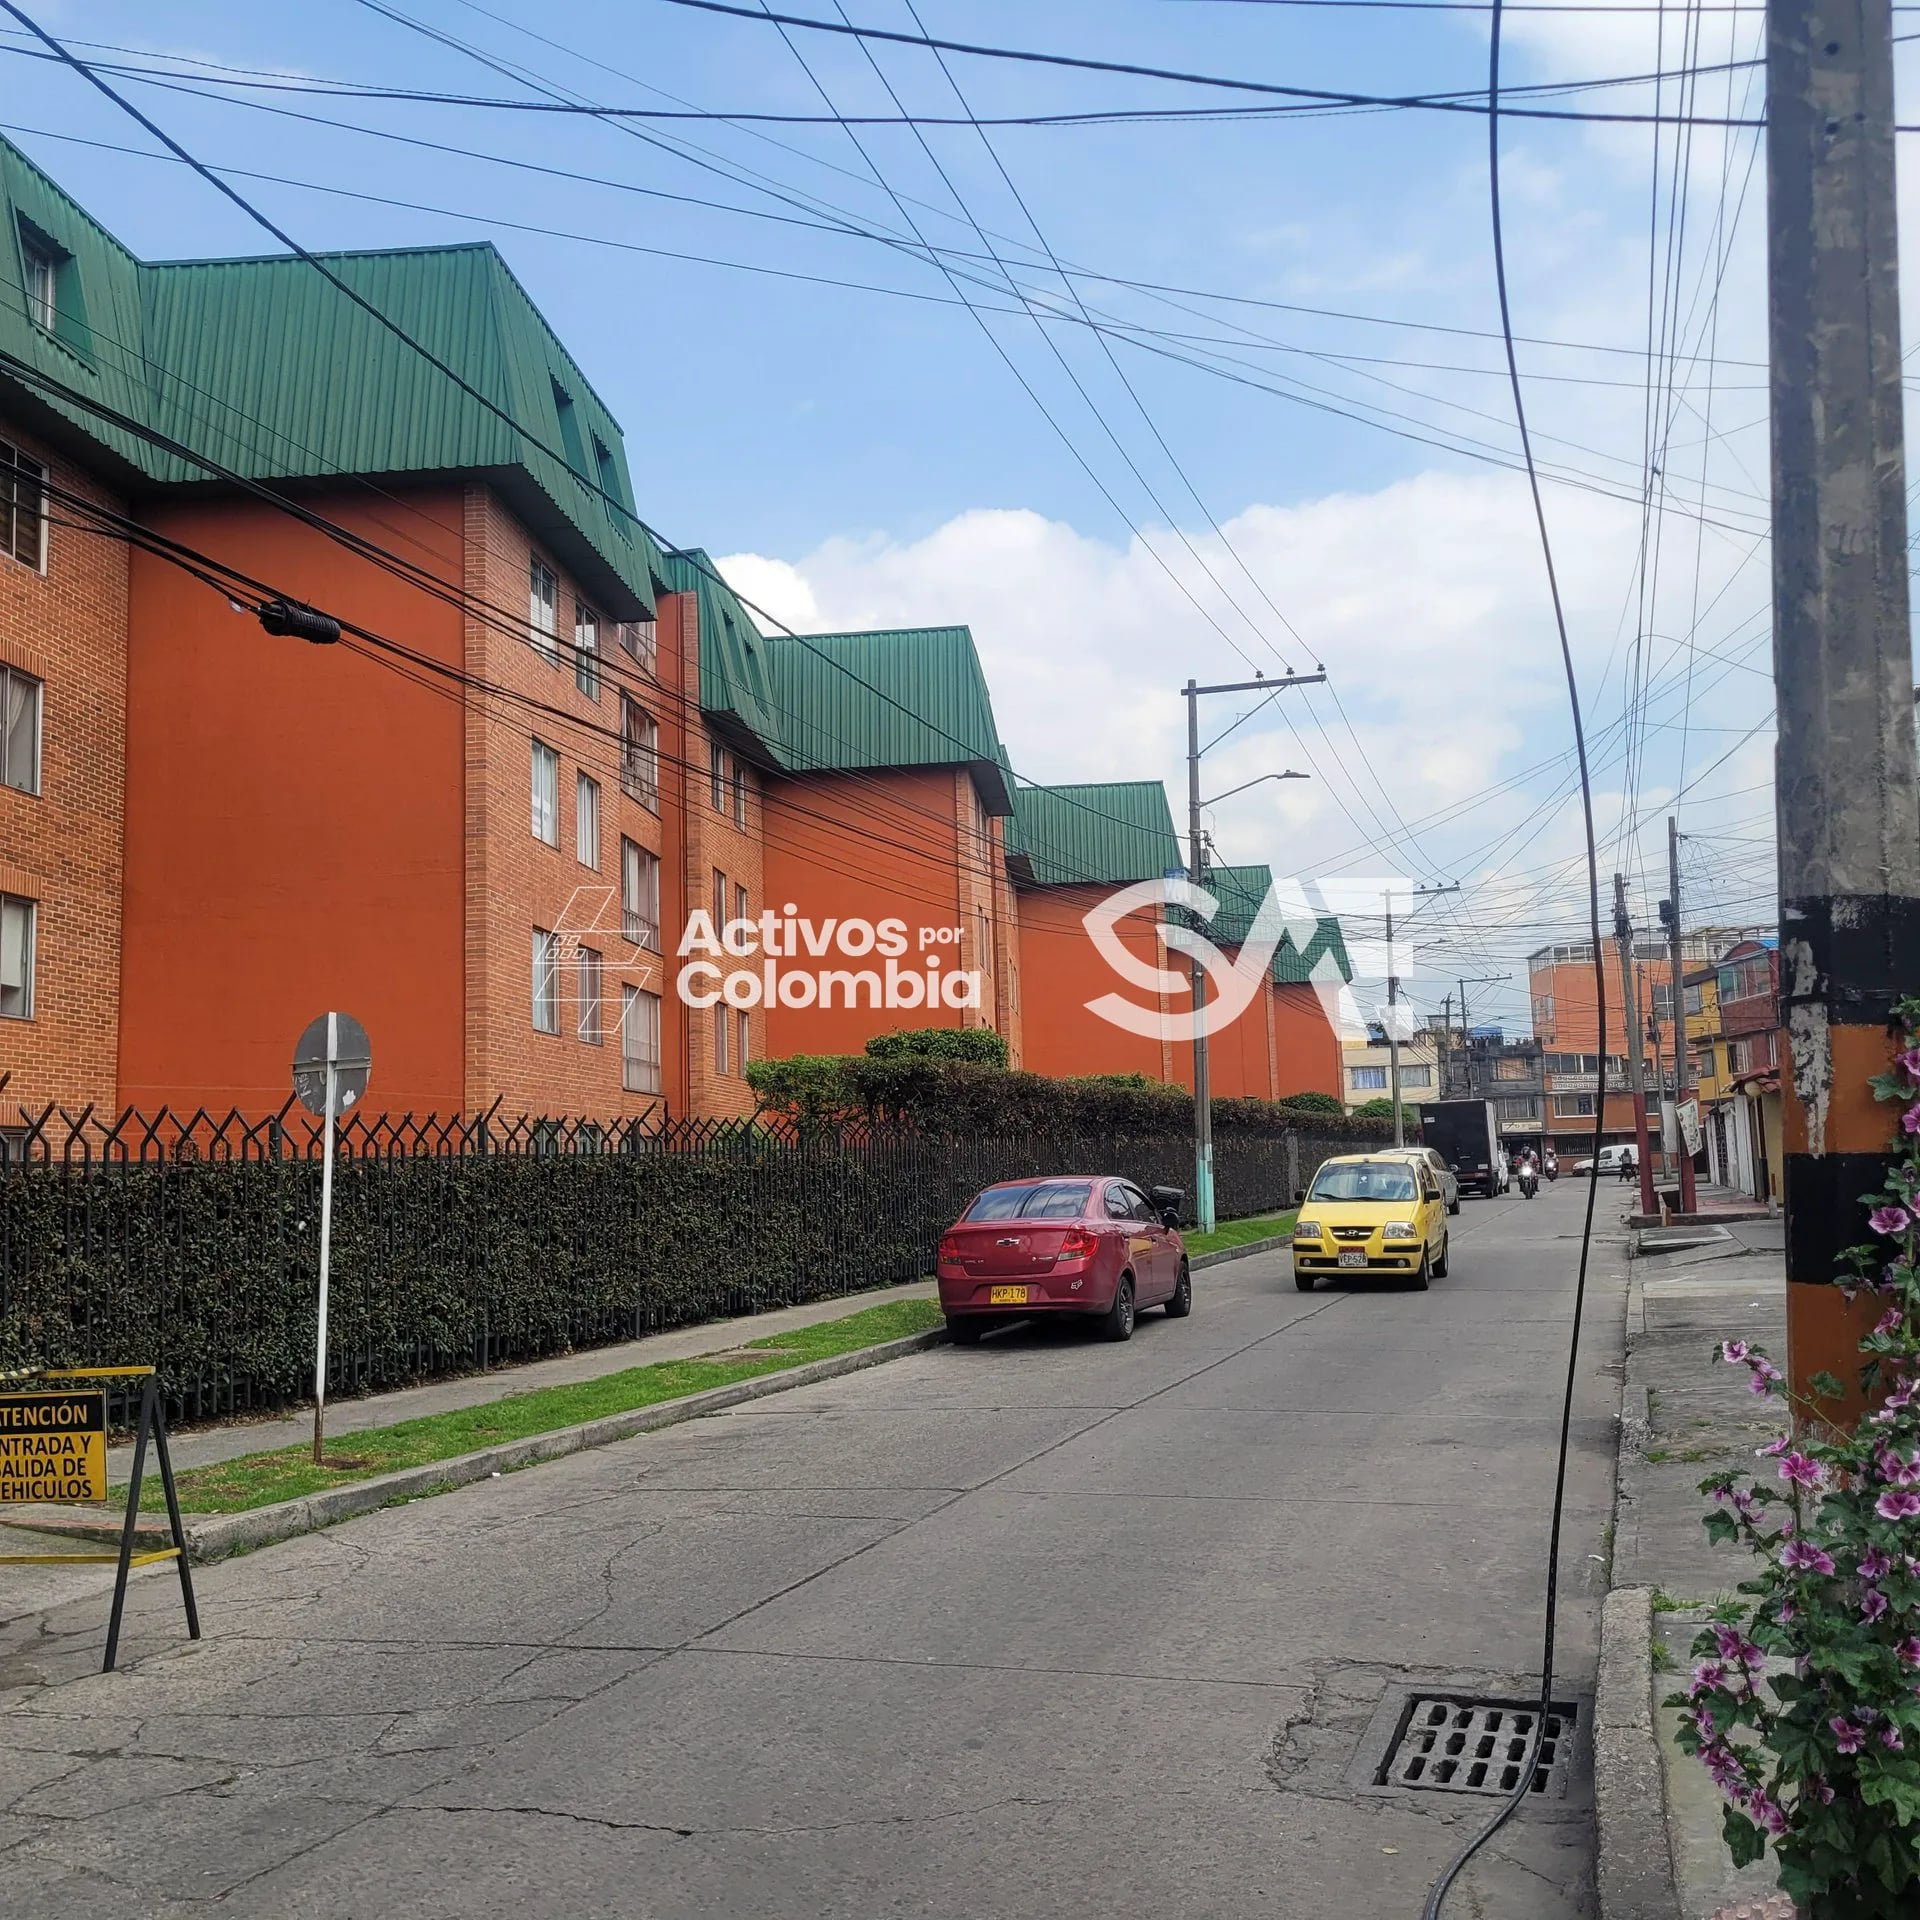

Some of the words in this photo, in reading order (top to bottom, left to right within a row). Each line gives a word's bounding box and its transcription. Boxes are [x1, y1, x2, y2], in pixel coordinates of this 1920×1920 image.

[0, 1400, 88, 1427] TENCIÓN
[0, 1435, 76, 1456] NTRADA
[80, 1435, 92, 1455] Y
[0, 1458, 57, 1478] ALIDA
[63, 1457, 87, 1477] DE
[0, 1479, 92, 1500] EHICULOS
